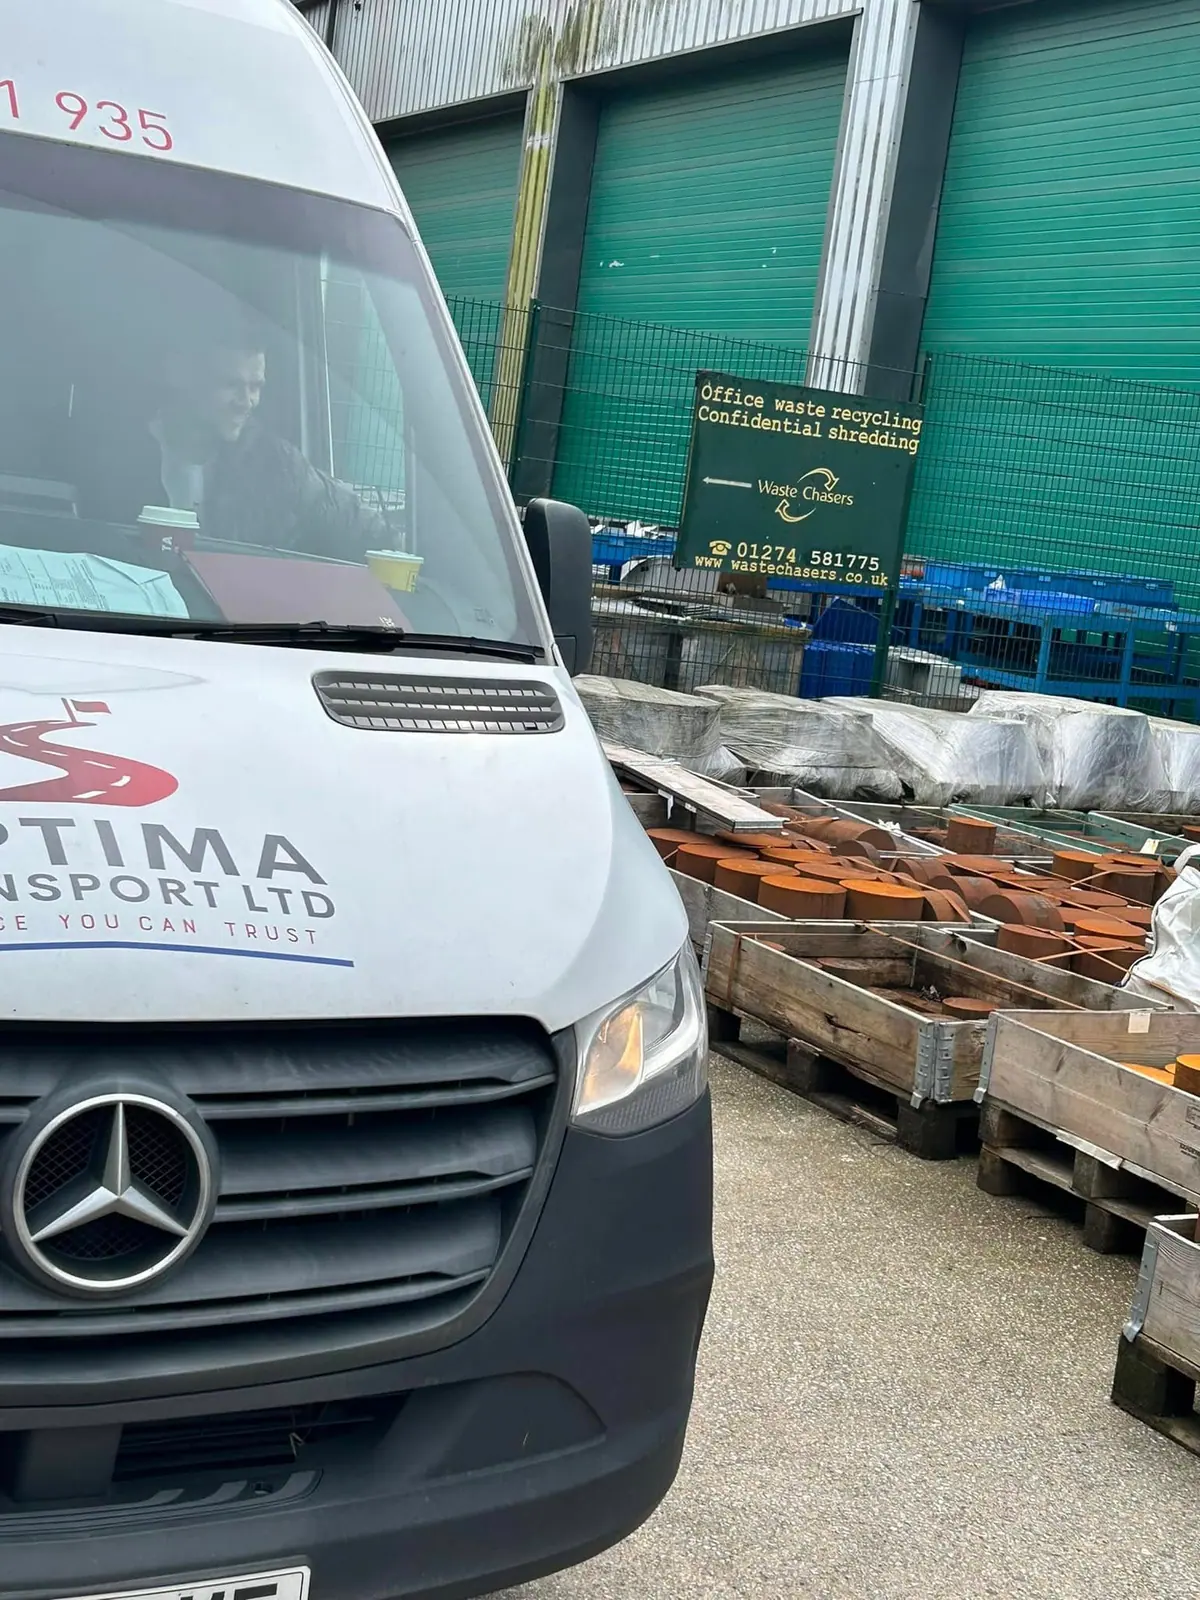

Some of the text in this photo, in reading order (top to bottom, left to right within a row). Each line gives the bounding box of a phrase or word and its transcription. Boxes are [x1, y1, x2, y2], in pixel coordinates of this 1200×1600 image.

[55, 91, 173, 151] 935
[701, 384, 922, 435] Office waste recycling
[698, 406, 920, 455] Confidential shredding
[757, 479, 854, 506] Waste Chasers
[731, 557, 888, 586] wastechasers.co.uk
[737, 542, 880, 571] 01274 581775
[242, 885, 336, 919] LTD
[59, 914, 119, 930] YOU
[139, 916, 197, 934] CAN
[224, 921, 316, 945] TRUST
